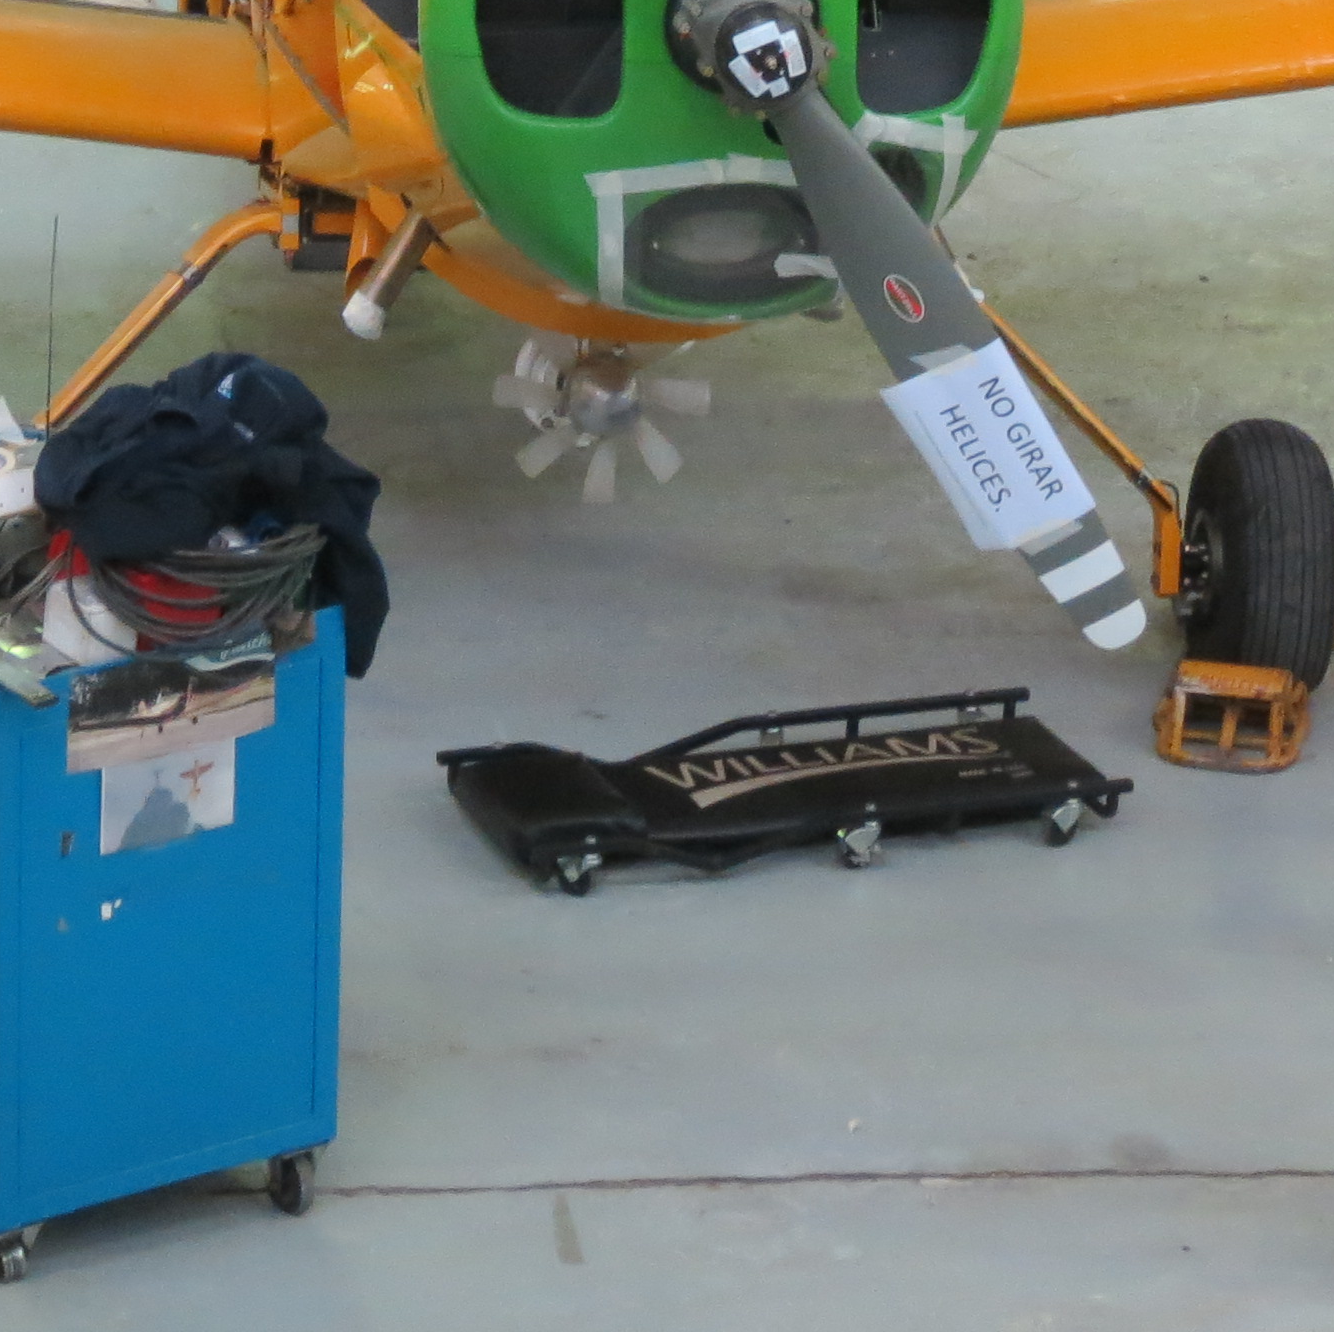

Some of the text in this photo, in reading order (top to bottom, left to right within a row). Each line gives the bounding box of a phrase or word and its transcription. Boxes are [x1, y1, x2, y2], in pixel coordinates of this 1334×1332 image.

[939, 404, 1011, 512] HELICES.
[978, 376, 1063, 501] NO GIRAR
[645, 726, 998, 789] WILLIAMS
